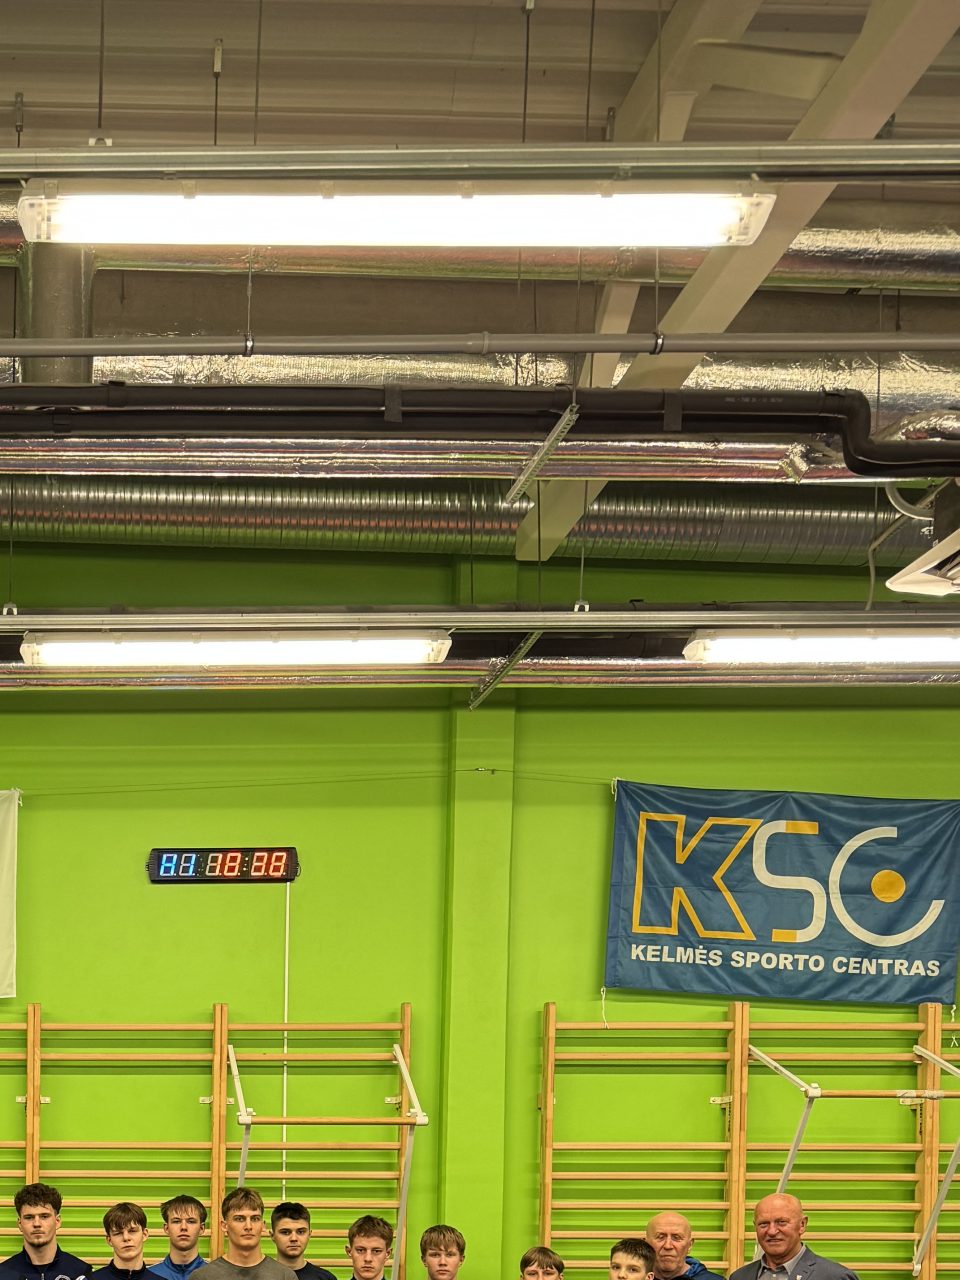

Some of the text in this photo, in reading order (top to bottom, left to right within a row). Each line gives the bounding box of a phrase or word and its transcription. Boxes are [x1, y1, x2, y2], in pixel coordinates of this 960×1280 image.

[632, 811, 945, 947] KSC
[631, 943, 941, 977] KELMĖS SPORTO CENTRAS
